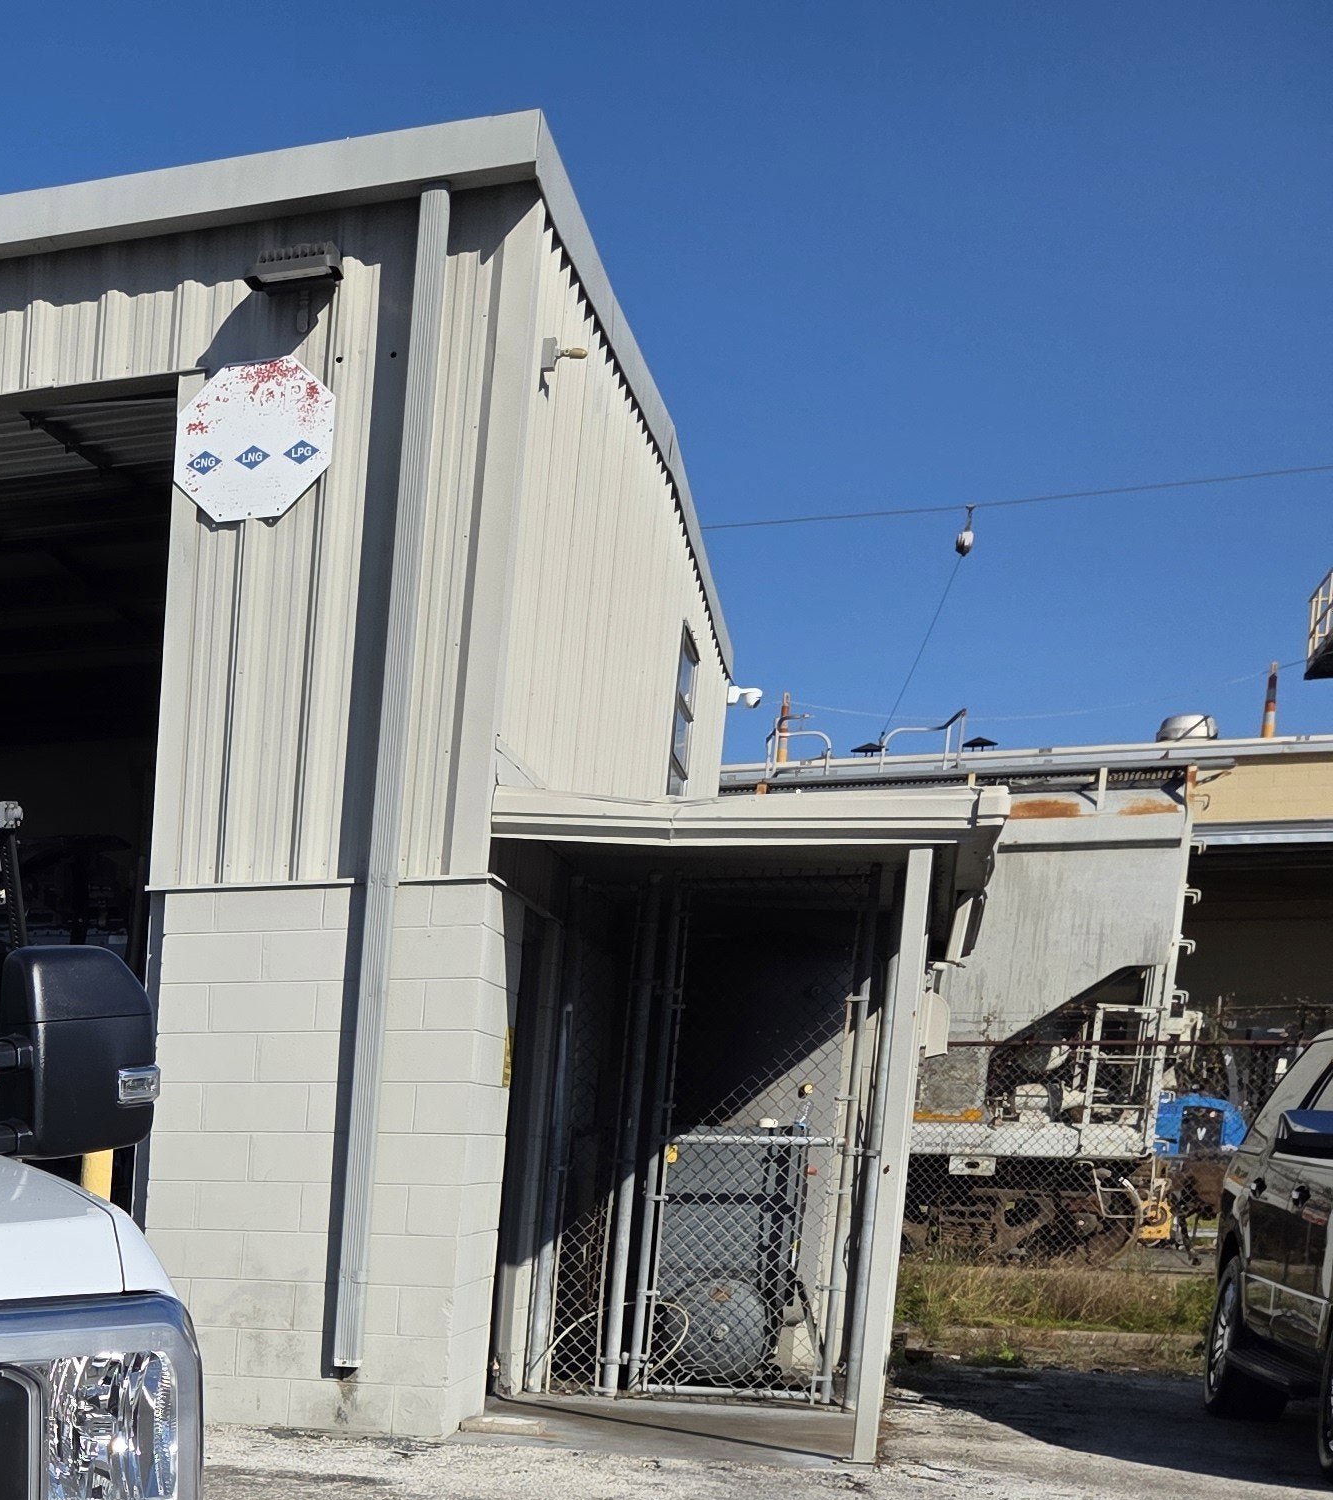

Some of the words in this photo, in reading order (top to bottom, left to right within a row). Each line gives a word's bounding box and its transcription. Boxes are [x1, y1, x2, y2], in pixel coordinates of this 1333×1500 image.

[193, 457, 216, 469] CNG
[242, 451, 263, 463] LNG
[291, 446, 312, 458] LPG
